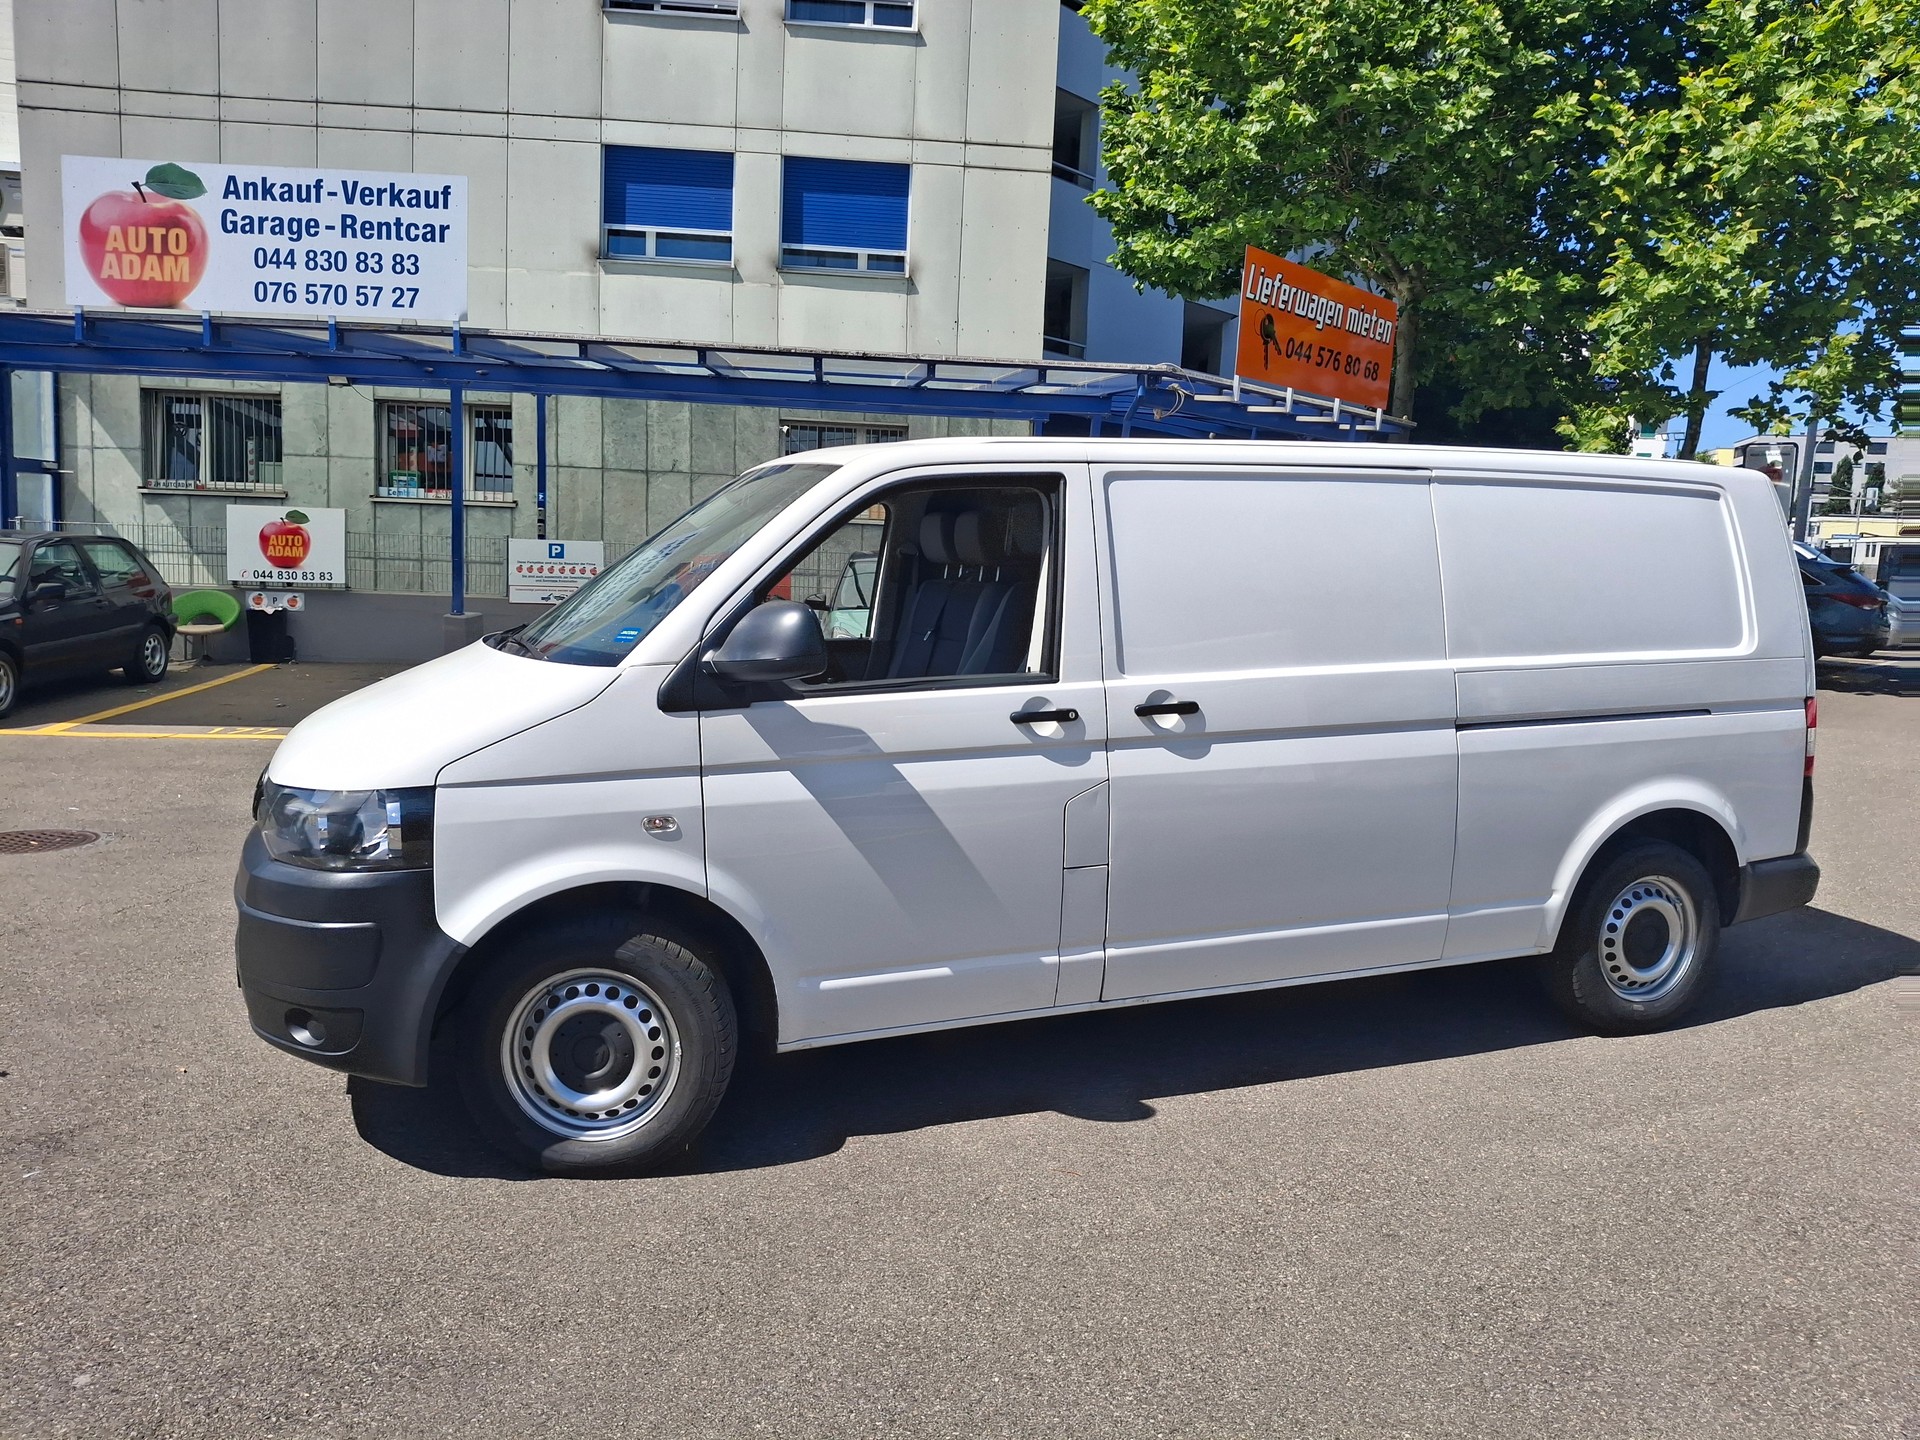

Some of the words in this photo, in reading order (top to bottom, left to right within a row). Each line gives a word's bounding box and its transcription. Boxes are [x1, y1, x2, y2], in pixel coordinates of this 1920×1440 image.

[105, 225, 188, 255] AUTO
[100, 253, 190, 283] ADAM
[254, 247, 297, 270] 044
[304, 249, 347, 272] 830
[355, 251, 384, 274] 83
[391, 253, 420, 276] 83
[254, 281, 297, 304] 076
[304, 283, 347, 306] 570
[355, 285, 384, 307] 57
[391, 286, 420, 308] 27
[1245, 264, 1344, 330] Lieferwagen
[1345, 305, 1393, 344] mieten
[1286, 338, 1312, 363] 044
[1315, 346, 1341, 371] 576
[1344, 354, 1361, 376] 80
[1363, 360, 1380, 381] 68
[267, 545, 304, 557] ADAM
[269, 535, 303, 546] AUTO
[551, 545, 561, 557] P
[253, 570, 274, 580] 044
[277, 570, 298, 580] 830
[302, 571, 315, 581] 83
[319, 572, 333, 581] 83
[272, 597, 278, 605] P
